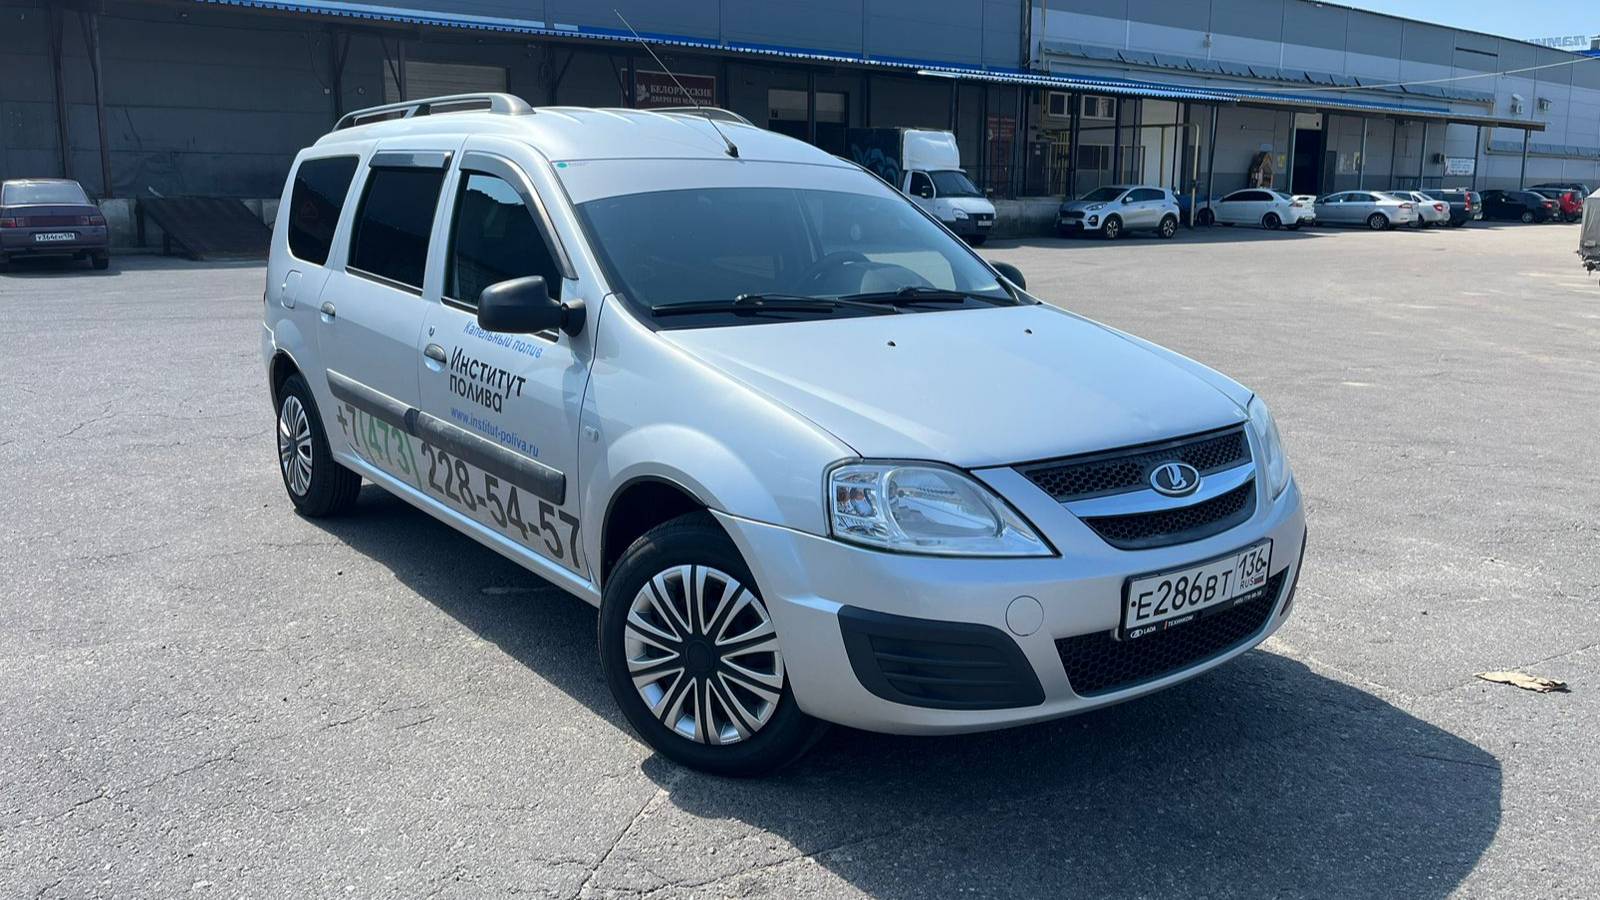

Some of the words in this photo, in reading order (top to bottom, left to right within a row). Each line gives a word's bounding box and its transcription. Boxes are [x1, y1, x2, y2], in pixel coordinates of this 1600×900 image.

[650, 84, 712, 96] БЕЛОРУССКИЕ
[464, 320, 512, 348] Капельный
[512, 341, 543, 359] полив
[450, 345, 526, 400] Институт
[449, 374, 503, 414] полива
[451, 407, 539, 457] www.institut-poliva.ru
[421, 442, 581, 569] 228-54-57
[1136, 571, 1233, 620] Е286ВТ
[1239, 548, 1264, 580] 136
[1240, 576, 1256, 590] RUS
[1143, 625, 1157, 635] LADA
